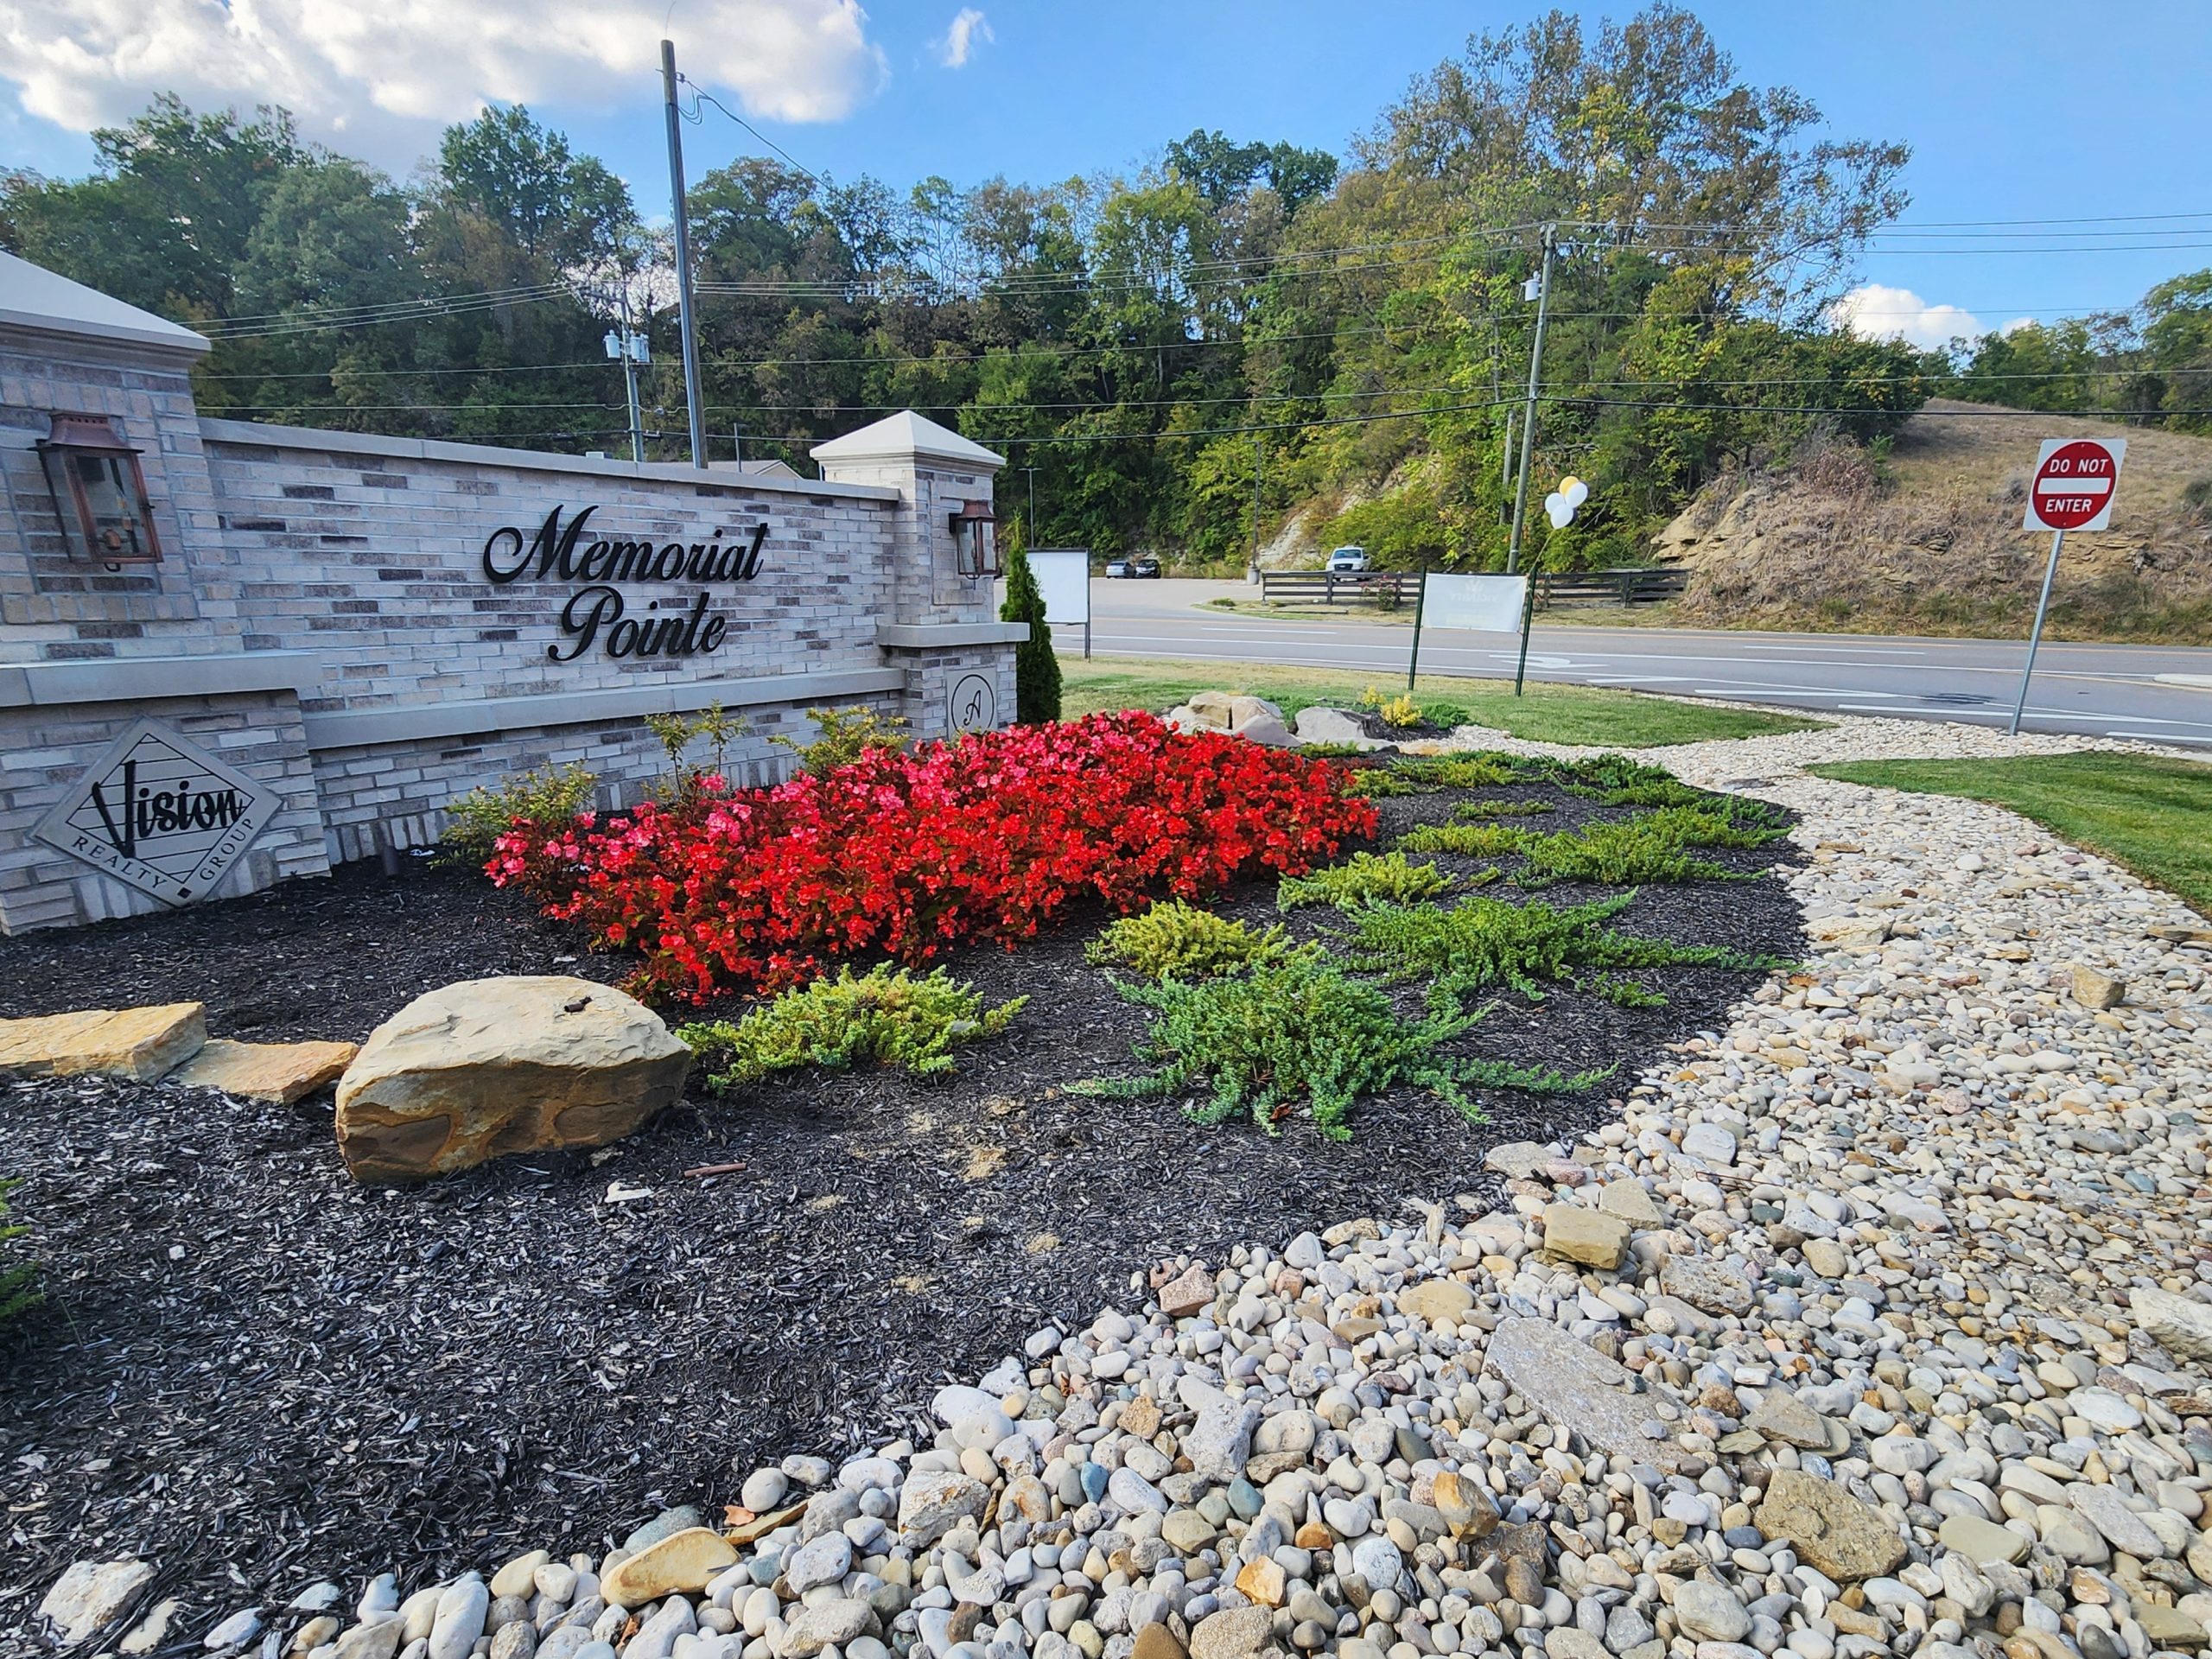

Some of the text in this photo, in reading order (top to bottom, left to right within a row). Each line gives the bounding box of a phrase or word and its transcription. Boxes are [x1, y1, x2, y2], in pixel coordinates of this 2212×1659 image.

[2049, 459, 2108, 473] DO NOT
[2045, 499, 2092, 512] ENTER
[483, 505, 768, 583] Memorial
[548, 586, 727, 661] Pointe
[963, 690, 982, 726] A
[92, 760, 242, 859] Vision
[72, 836, 168, 890] REALTY
[199, 817, 254, 881] GROUP
